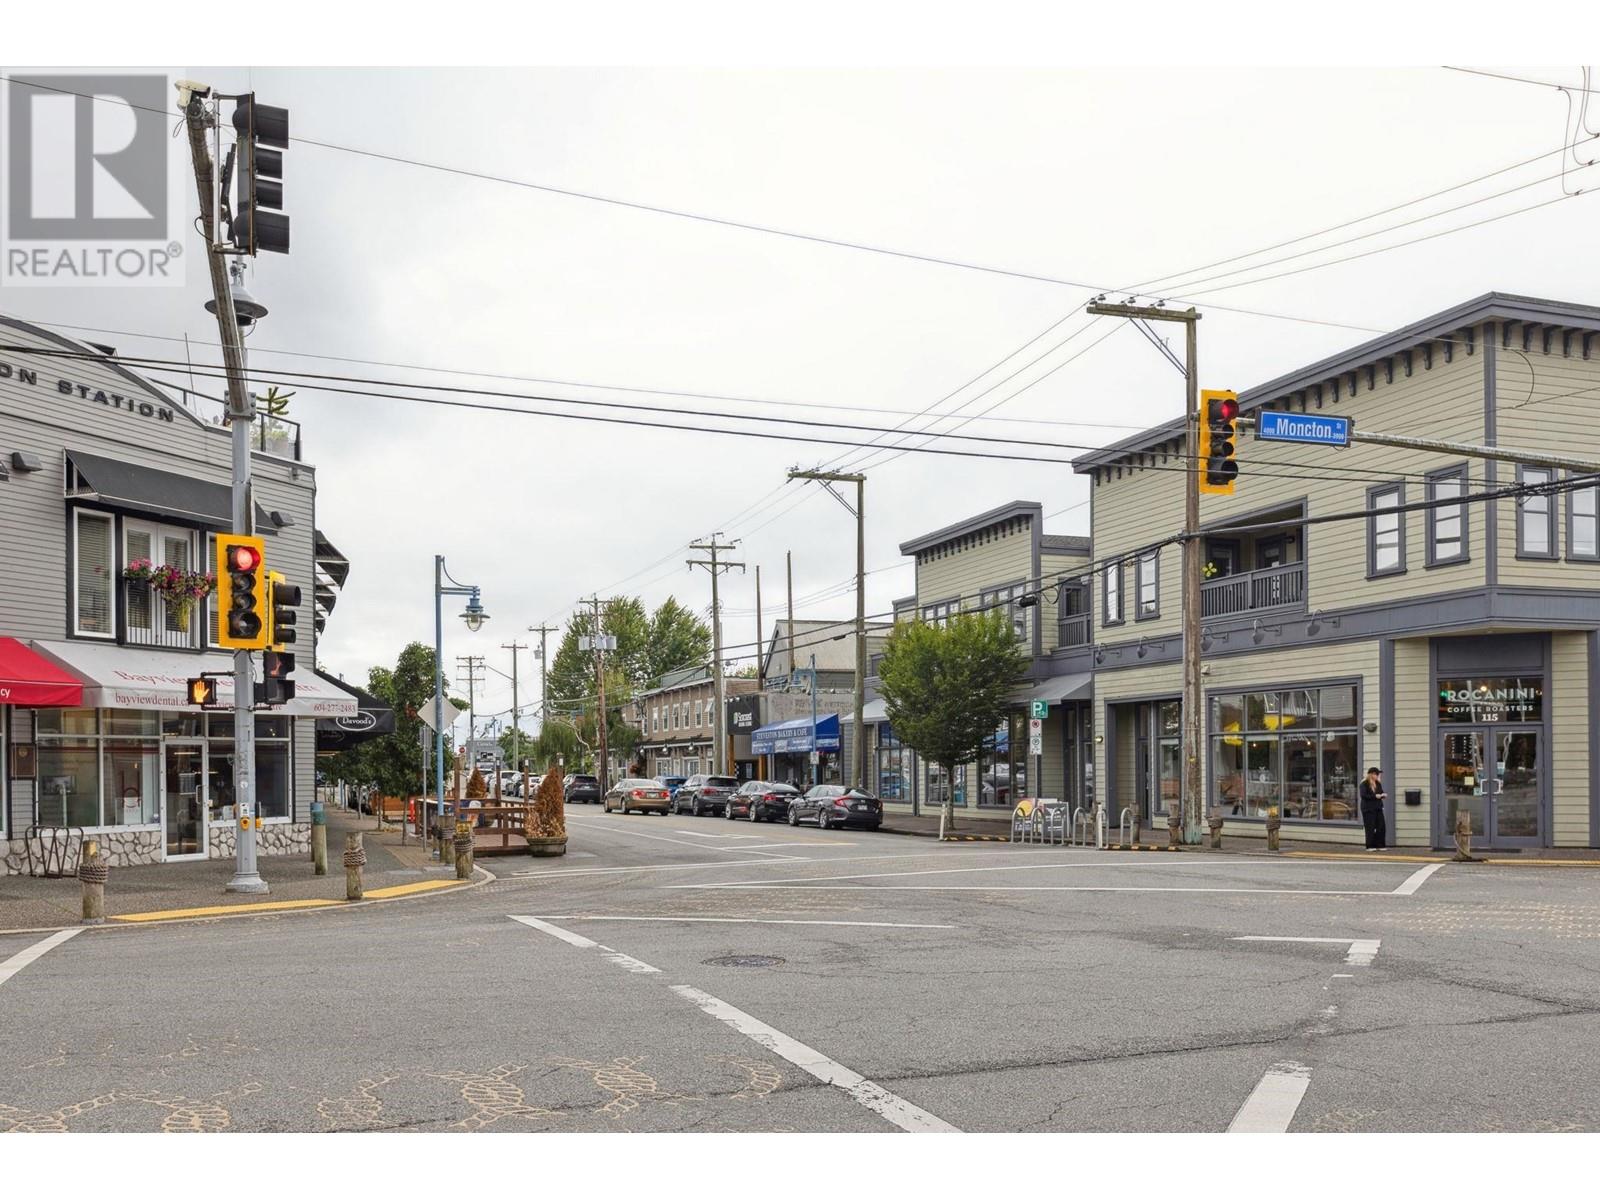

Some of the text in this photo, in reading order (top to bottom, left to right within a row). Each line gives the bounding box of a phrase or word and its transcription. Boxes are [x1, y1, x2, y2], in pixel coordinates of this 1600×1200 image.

[57, 379, 174, 423] STATION
[1276, 418, 1332, 438] Moncton
[112, 668, 188, 685] Bayvie
[1447, 688, 1535, 701] ROCANINI
[1032, 701, 1043, 717] P
[1447, 704, 1534, 713] COFFEE ROASTERS
[1481, 713, 1499, 722] 115
